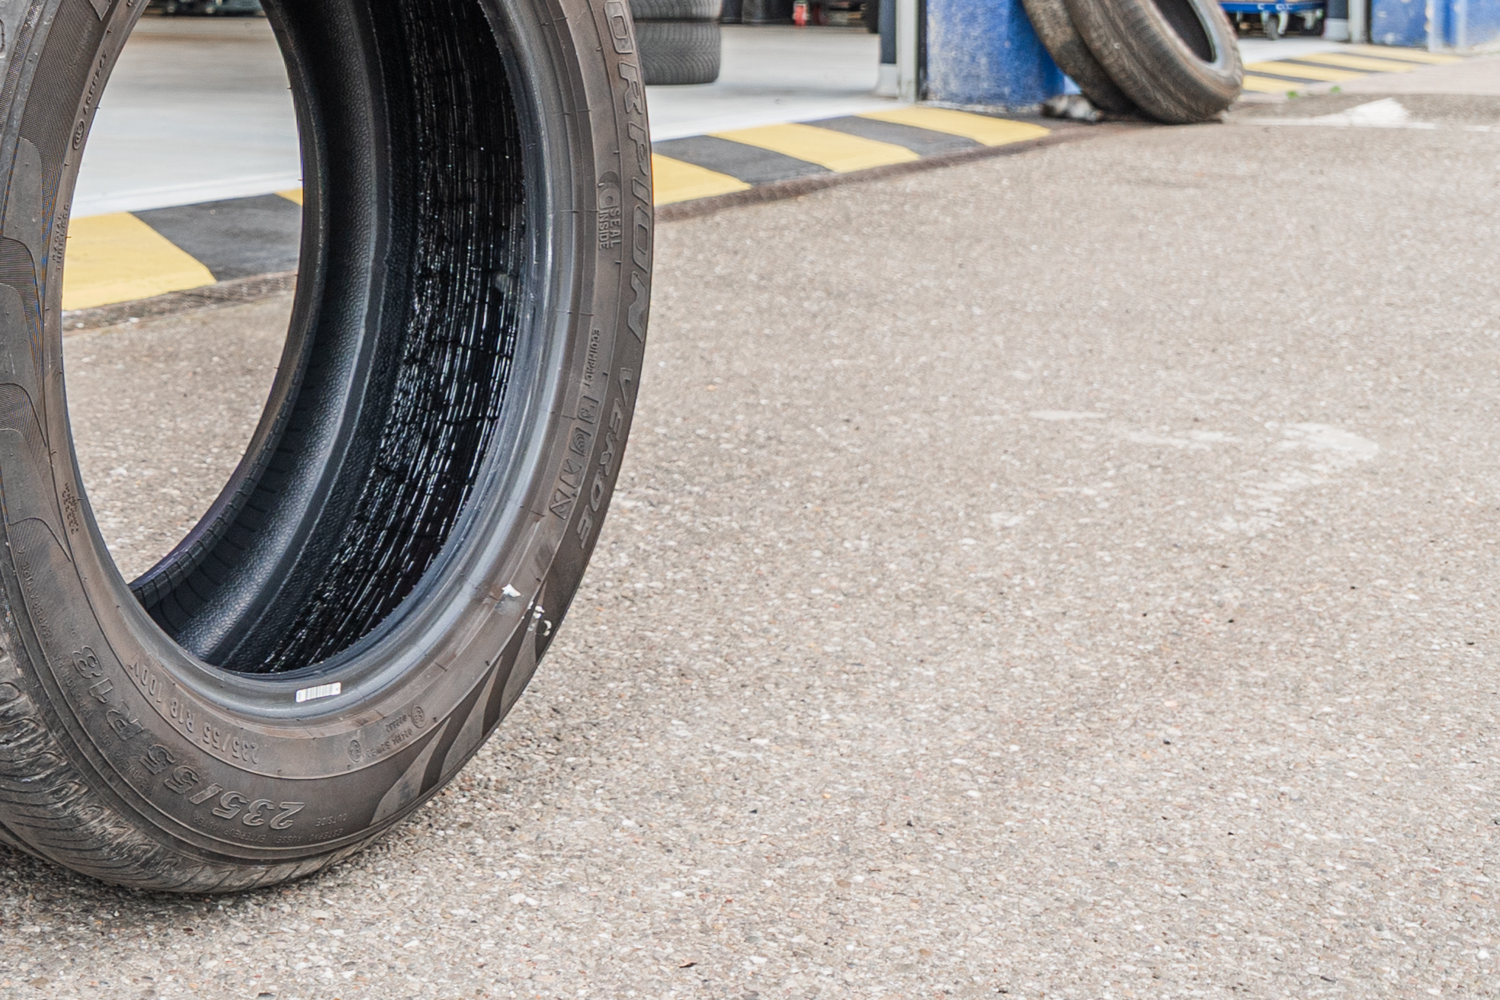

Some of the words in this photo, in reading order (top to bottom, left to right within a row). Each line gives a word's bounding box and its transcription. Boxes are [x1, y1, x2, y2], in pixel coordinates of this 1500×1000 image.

[598, 205, 609, 250] INSIDE
[608, 205, 621, 249] SEAL
[583, 328, 600, 387] ECOIMPACT
[576, 367, 633, 549] VERDE
[72, 645, 144, 742] R18
[170, 700, 196, 733] R18
[202, 722, 259, 765] 235/55
[139, 743, 305, 830] 235/55
